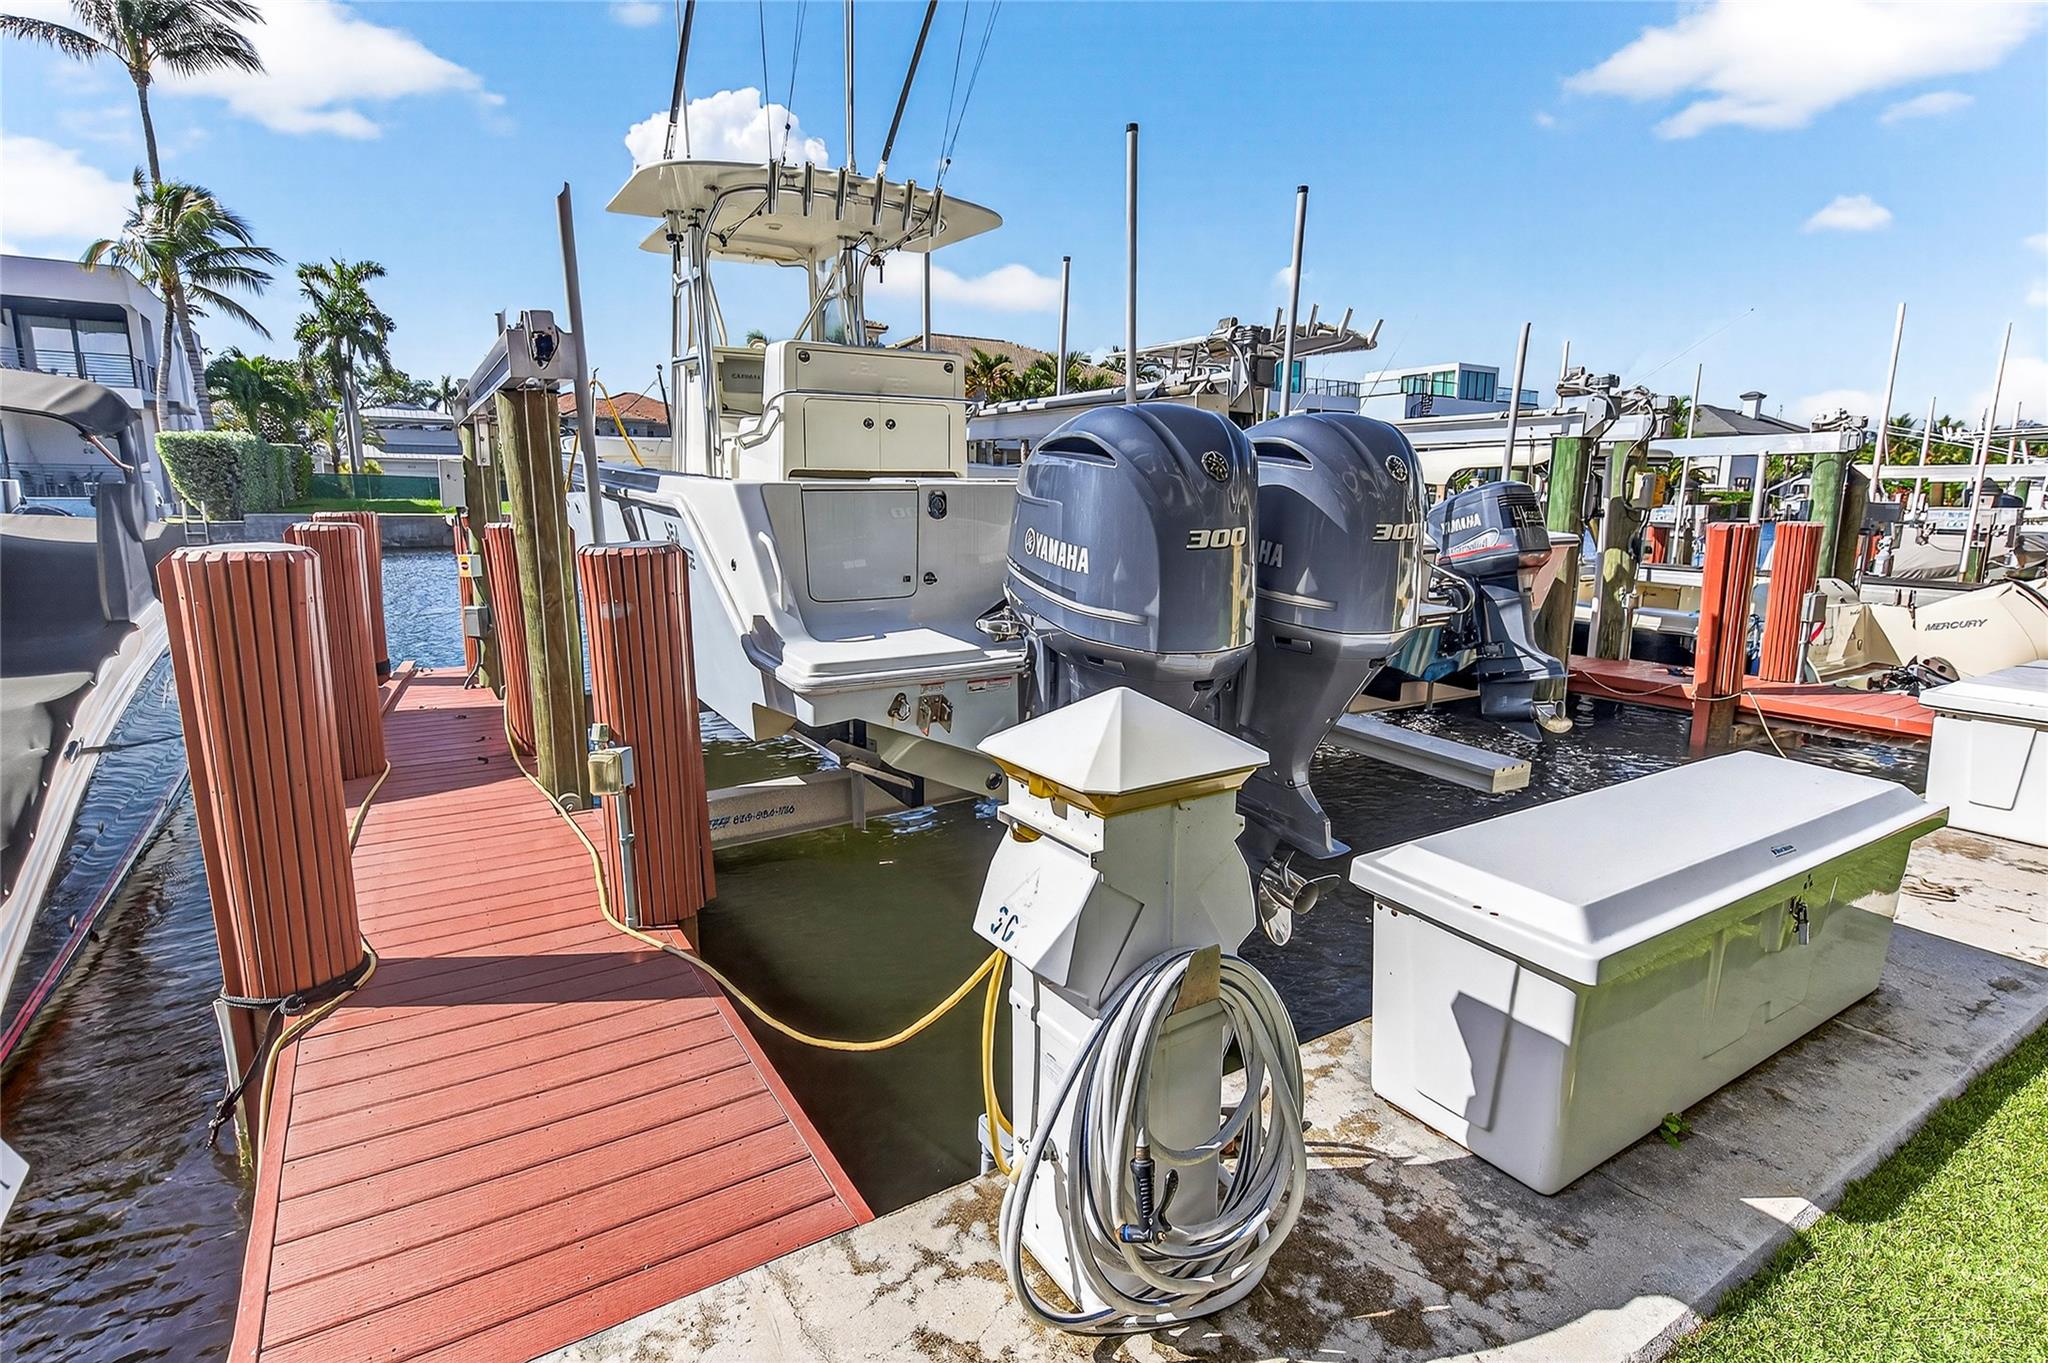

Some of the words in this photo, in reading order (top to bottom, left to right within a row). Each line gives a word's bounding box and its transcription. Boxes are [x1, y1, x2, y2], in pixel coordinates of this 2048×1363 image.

[1186, 526, 1247, 549] 300
[1372, 523, 1418, 540] 300
[1036, 532, 1089, 575] YAMAHA
[1924, 619, 1988, 631] MERCURY
